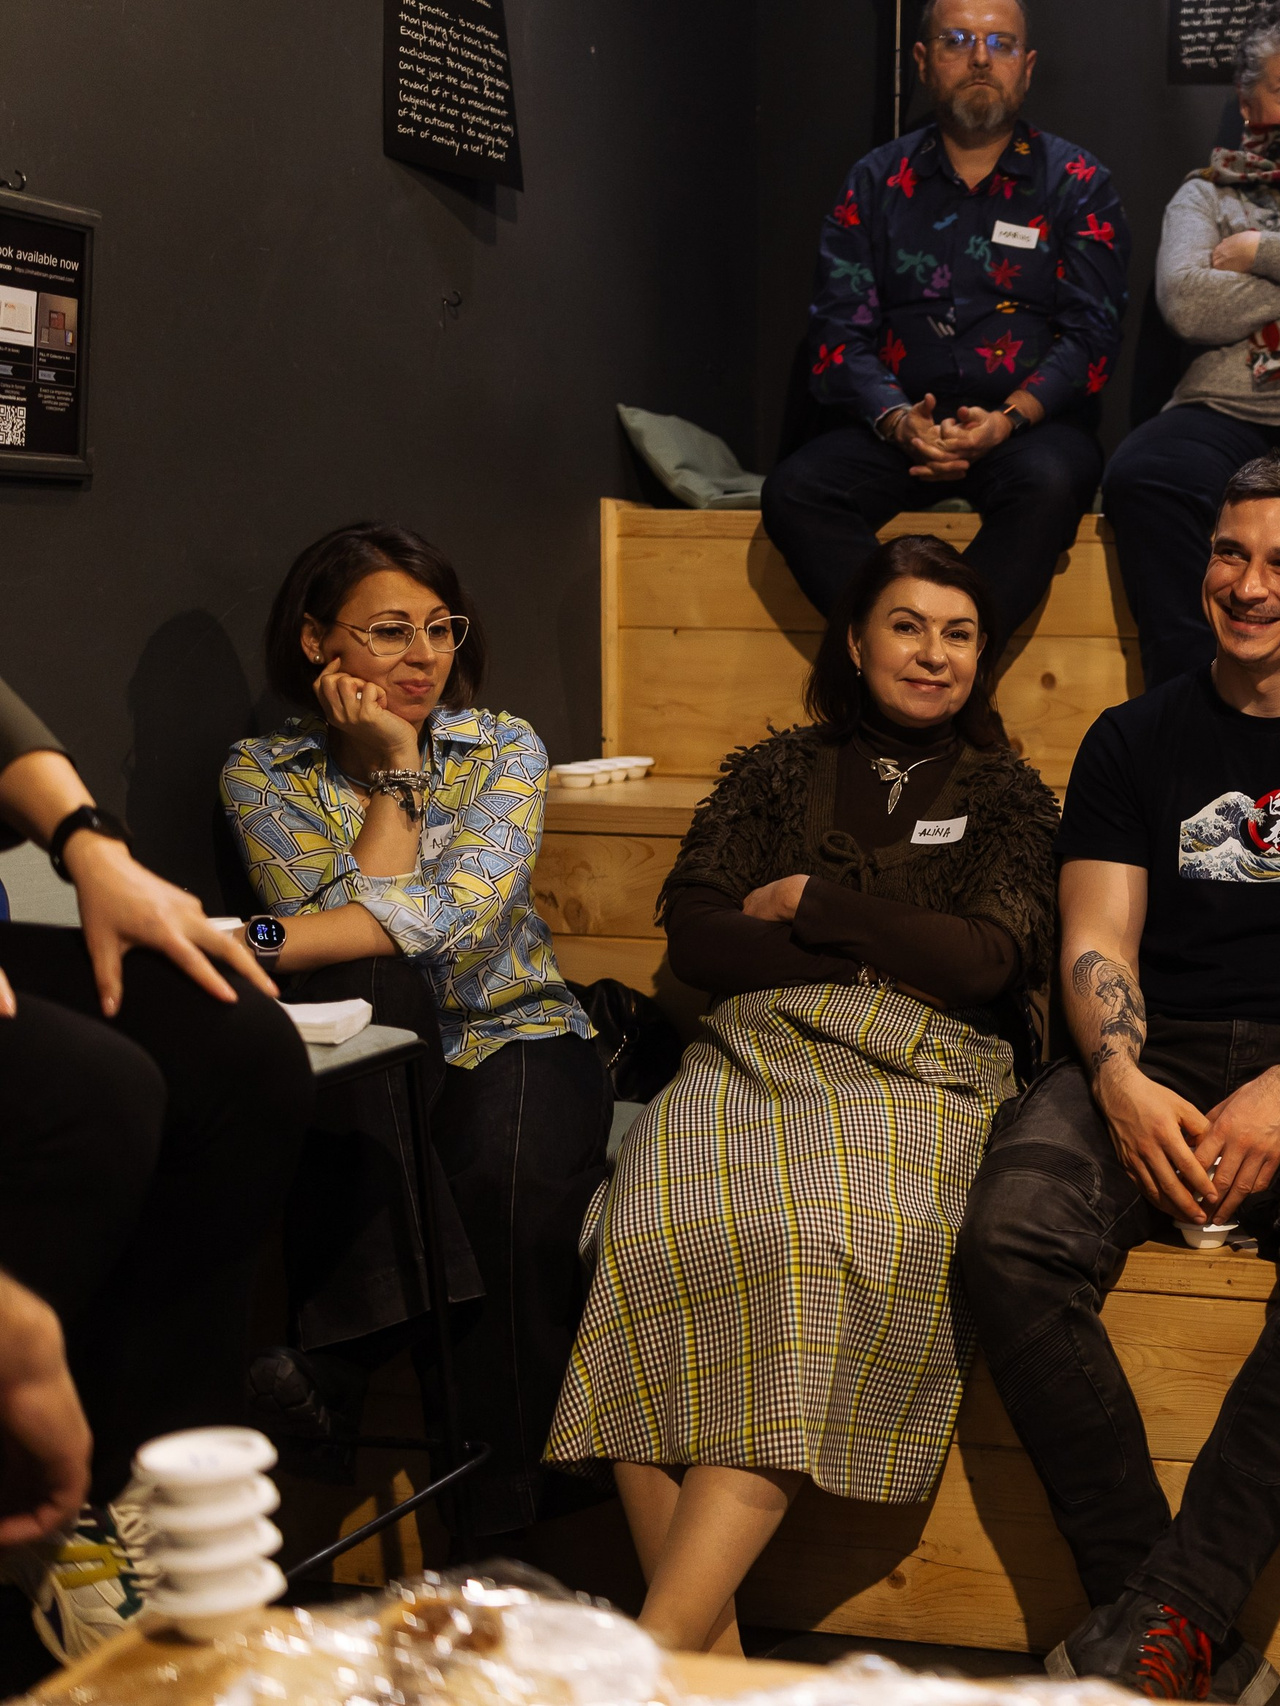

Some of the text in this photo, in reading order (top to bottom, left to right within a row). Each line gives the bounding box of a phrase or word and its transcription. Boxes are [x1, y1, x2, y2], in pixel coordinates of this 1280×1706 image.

[398, 11, 420, 26] than
[422, 20, 448, 41] playing
[448, 26, 462, 41] for
[466, 21, 476, 30] no
[400, 25, 428, 47] Except
[428, 37, 446, 50] that
[460, 47, 489, 71] listening
[488, 58, 496, 68] to
[399, 45, 444, 66] audiobook.
[446, 56, 475, 80] Perhaps
[416, 64, 426, 76] be
[426, 66, 445, 82] just
[445, 74, 458, 85] the
[399, 78, 429, 93] reward
[431, 86, 441, 96] of
[442, 88, 450, 98] it
[451, 91, 459, 102] is
[459, 97, 466, 105] a
[446, 108, 460, 117] not
[398, 107, 409, 117] of
[409, 111, 422, 123] the
[466, 126, 476, 137] do
[477, 132, 496, 149] enjoy
[495, 136, 509, 149] this
[420, 129, 430, 139] of
[432, 134, 460, 156] activity
[462, 143, 469, 152] a
[470, 143, 483, 156] lot!
[16, 249, 58, 267] available
[60, 258, 79, 271] now
[918, 825, 951, 838] ALINA
